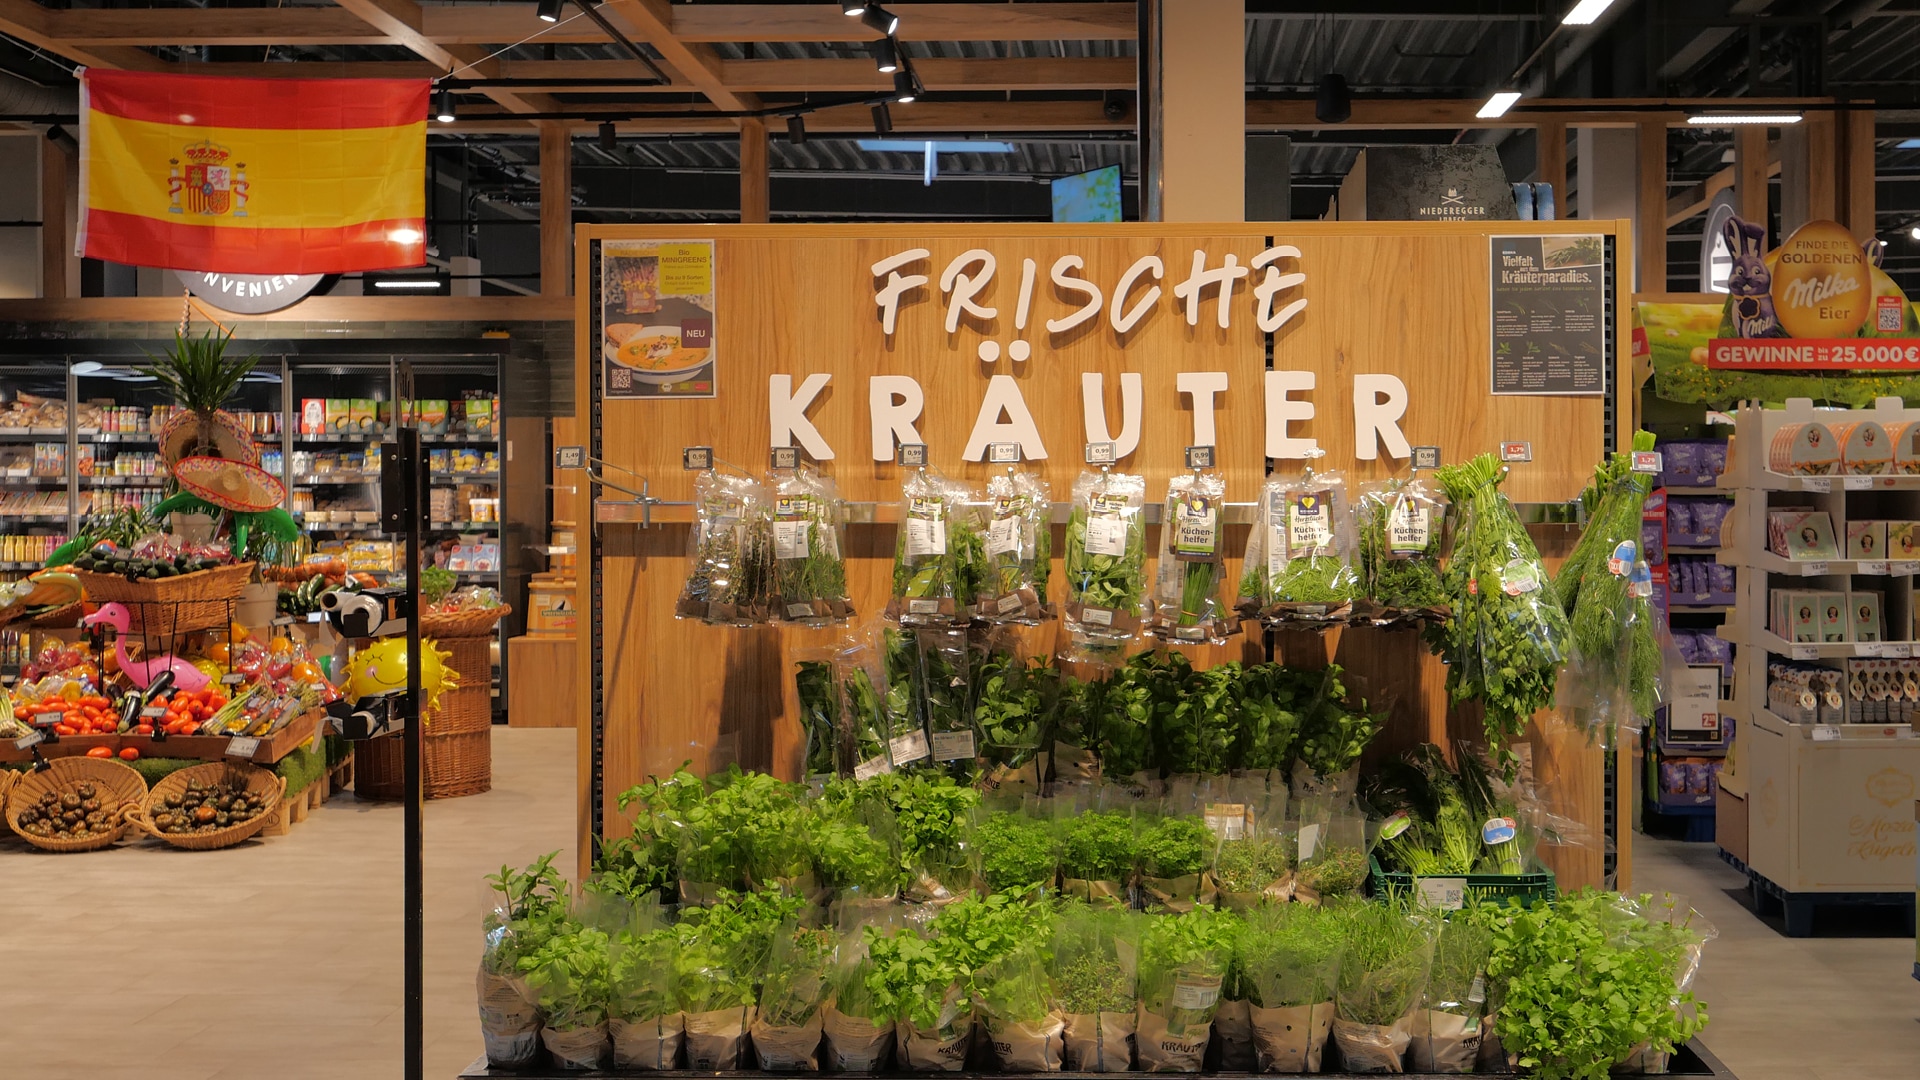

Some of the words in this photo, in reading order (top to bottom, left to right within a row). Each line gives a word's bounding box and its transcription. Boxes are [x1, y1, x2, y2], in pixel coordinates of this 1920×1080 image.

[1420, 207, 1485, 215] NIEDEREGGER
[1796, 241, 1828, 249] FINDE
[1831, 241, 1849, 249] DIE
[1502, 256, 1534, 267] Vielfalt
[1781, 253, 1862, 265] GOLDENEN
[1502, 270, 1592, 286] Kräuterparadies.
[203, 271, 299, 297] NVENIEN
[871, 246, 1308, 335] FRISCHE
[1783, 272, 1860, 309] Milka
[1819, 306, 1851, 320] Eier
[686, 329, 705, 338] NEU
[1716, 346, 1815, 363] GEWINNE
[769, 339, 1411, 462] KRÄUTER
[1181, 526, 1214, 536] Küchen-
[1394, 526, 1427, 535] Küchen-
[1183, 535, 1209, 544] helfer
[1397, 534, 1423, 542] helfer
